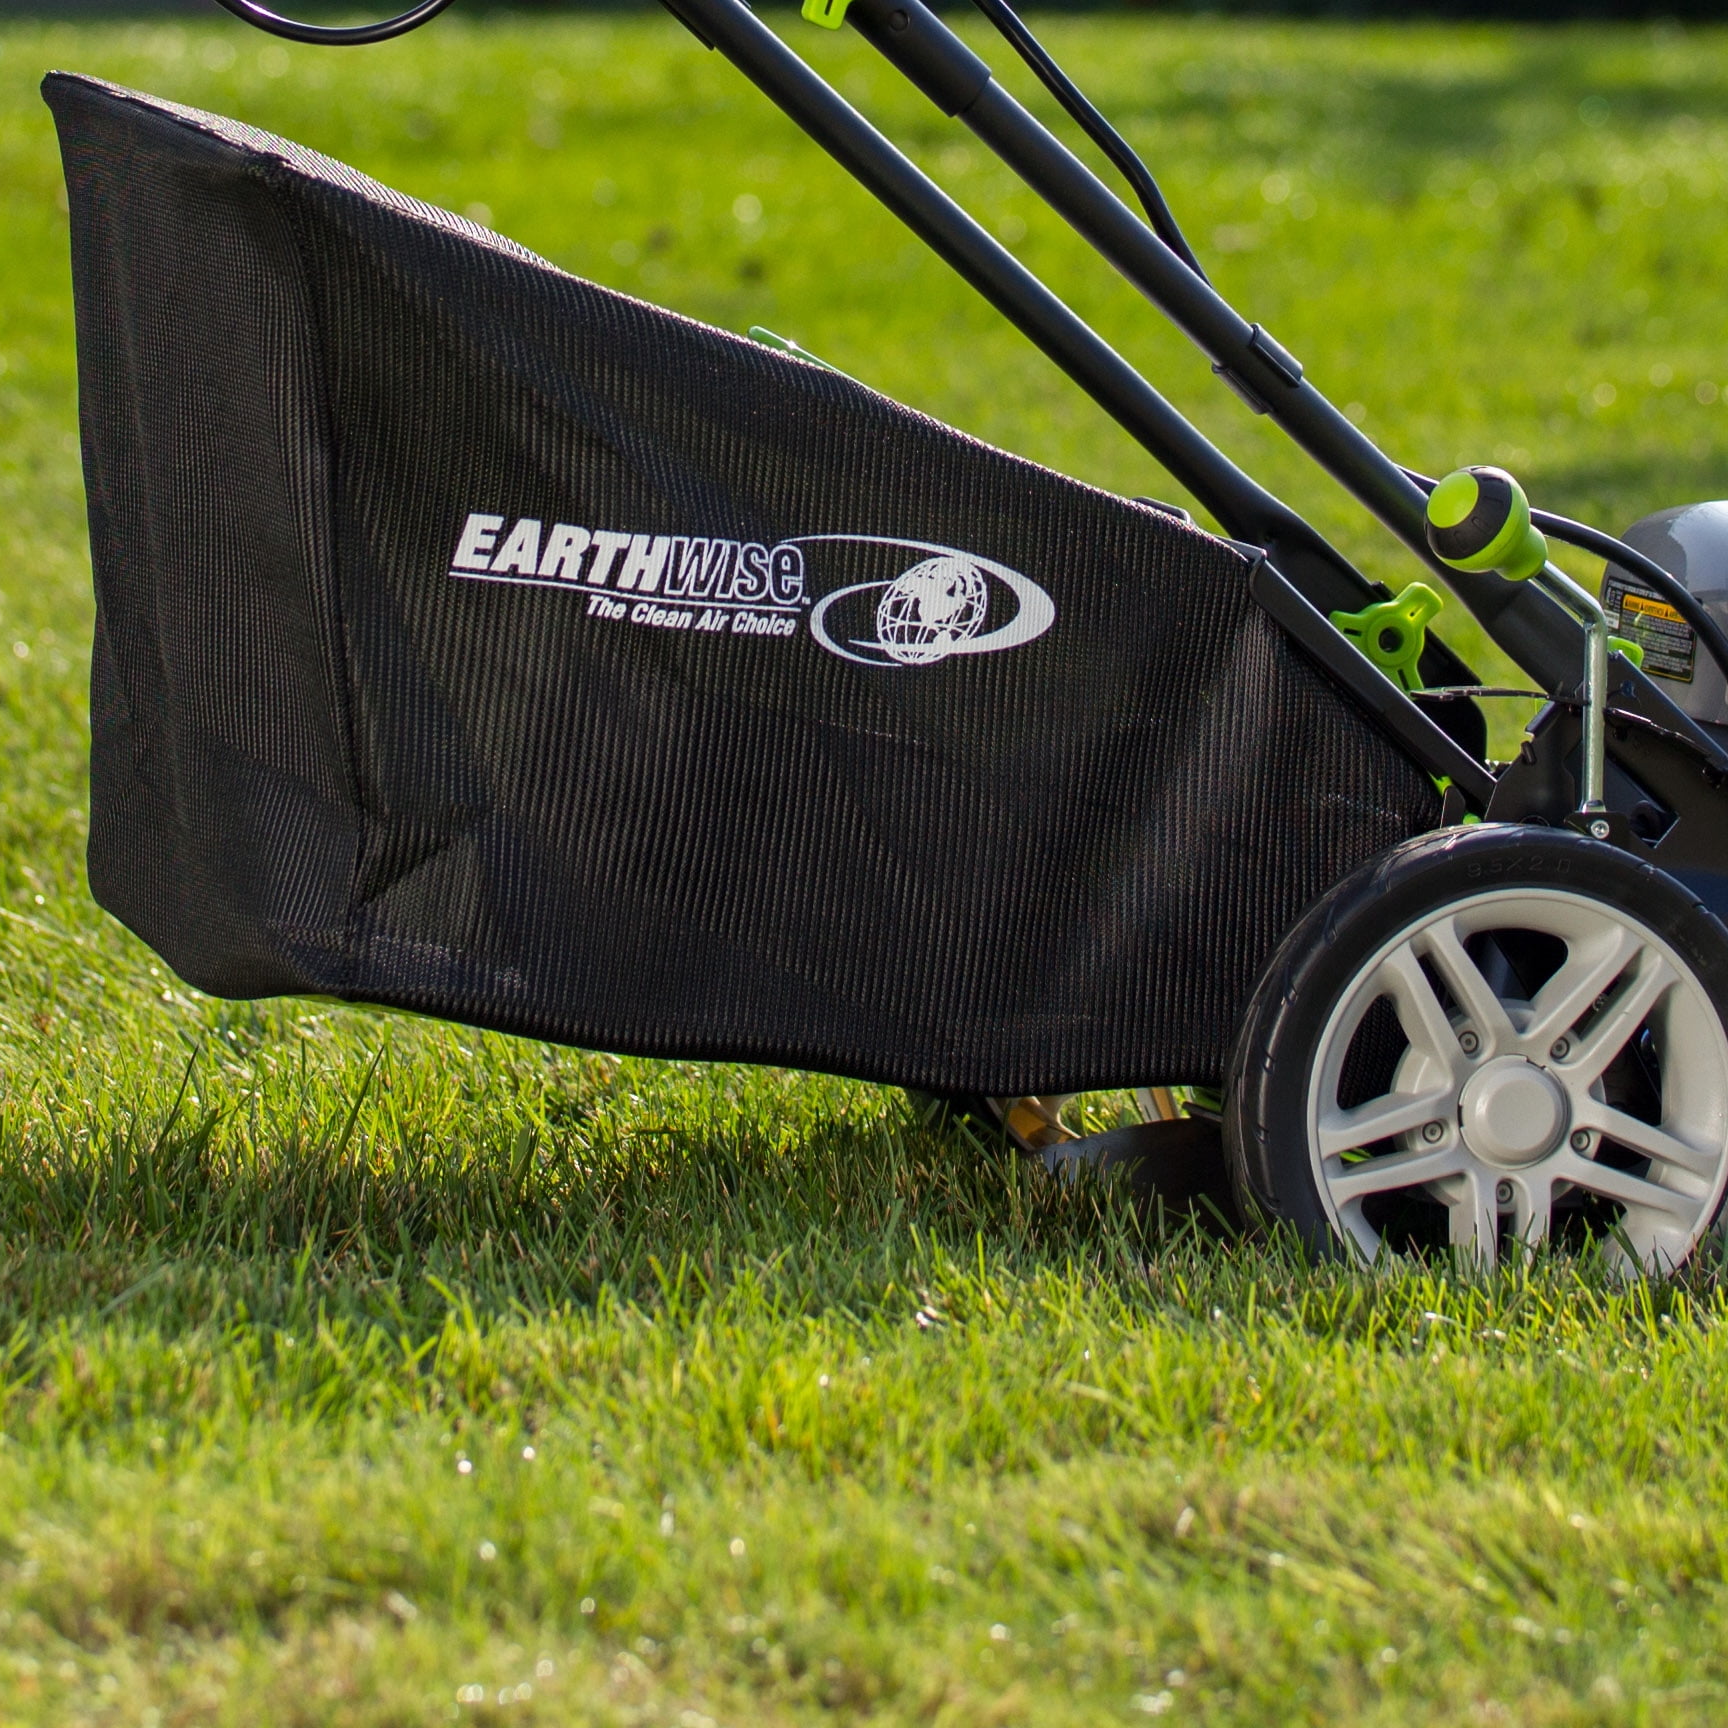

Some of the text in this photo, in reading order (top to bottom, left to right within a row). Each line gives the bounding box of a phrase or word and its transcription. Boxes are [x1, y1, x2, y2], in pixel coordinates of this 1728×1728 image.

[586, 594, 797, 636] The Clean Air Choice
